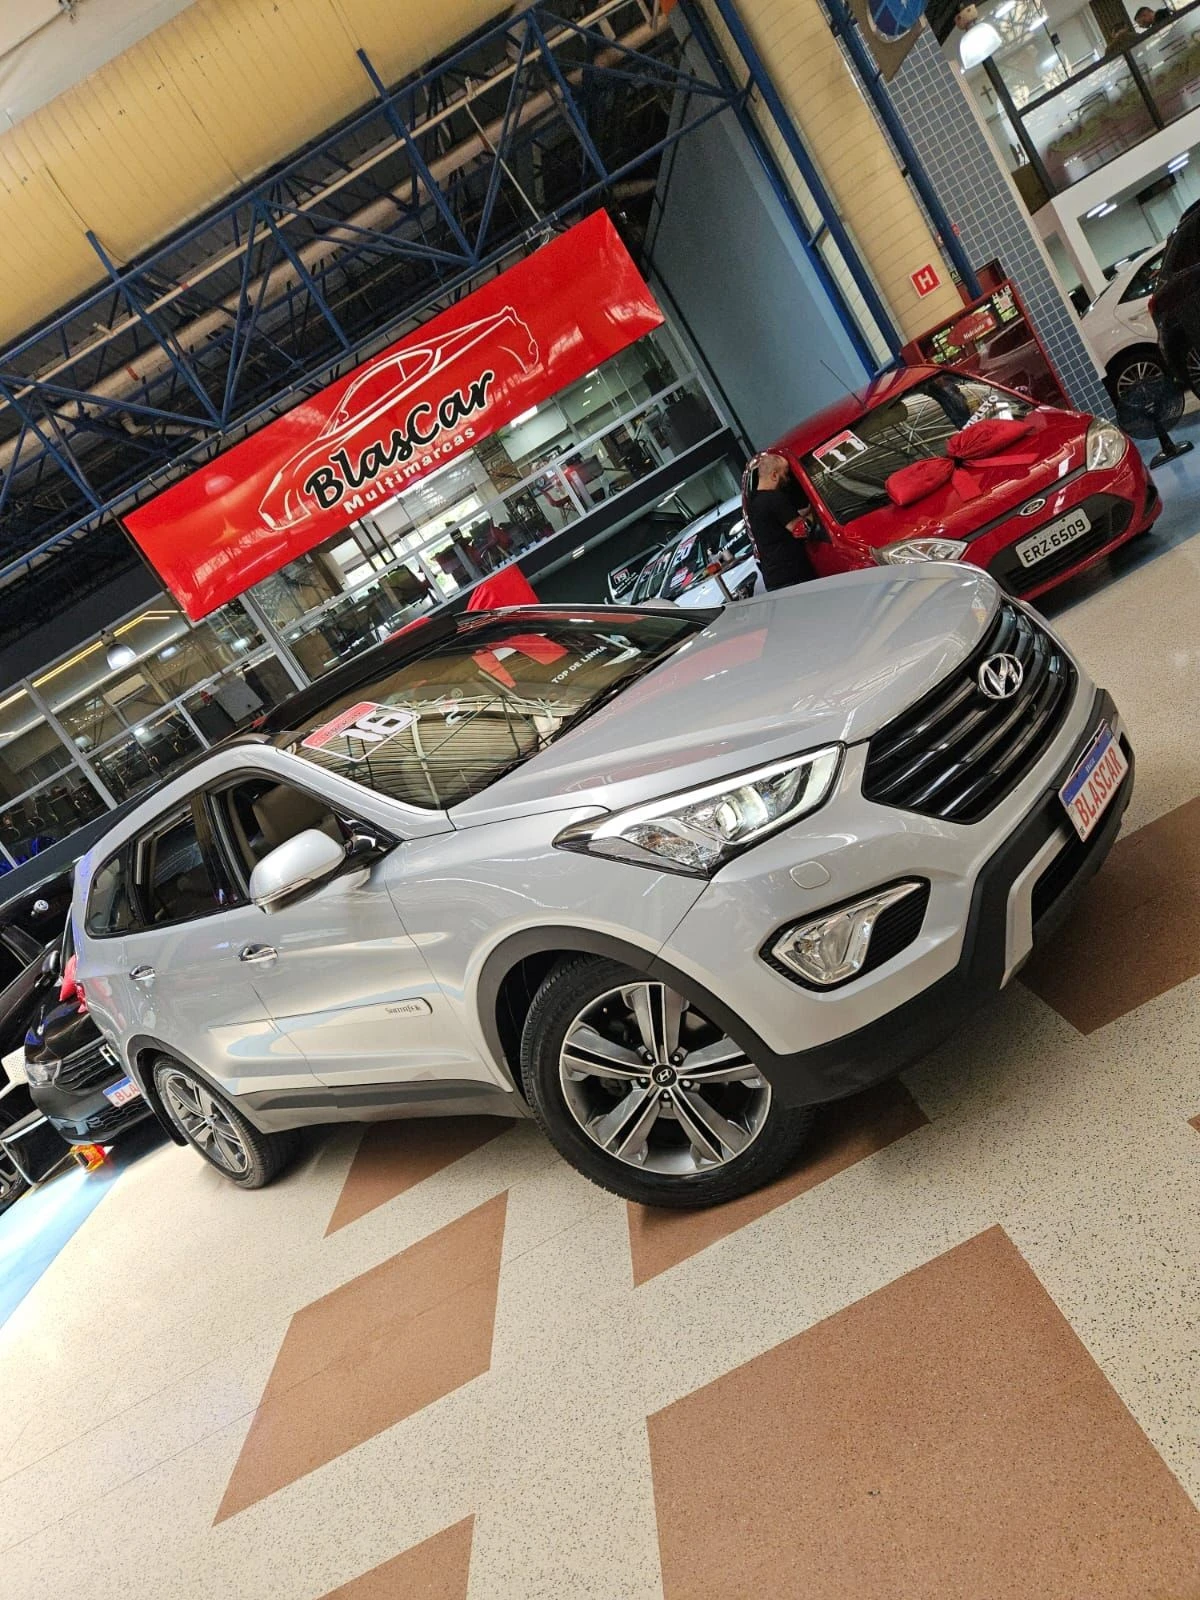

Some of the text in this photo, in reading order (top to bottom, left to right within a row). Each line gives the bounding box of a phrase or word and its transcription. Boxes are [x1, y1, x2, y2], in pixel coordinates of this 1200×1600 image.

[917, 270, 934, 290] H
[303, 369, 495, 510] BlasCar
[342, 426, 476, 514] Multimarcas
[551, 645, 608, 684] TOP DE LINHA
[1074, 747, 1123, 828] BLASCAR
